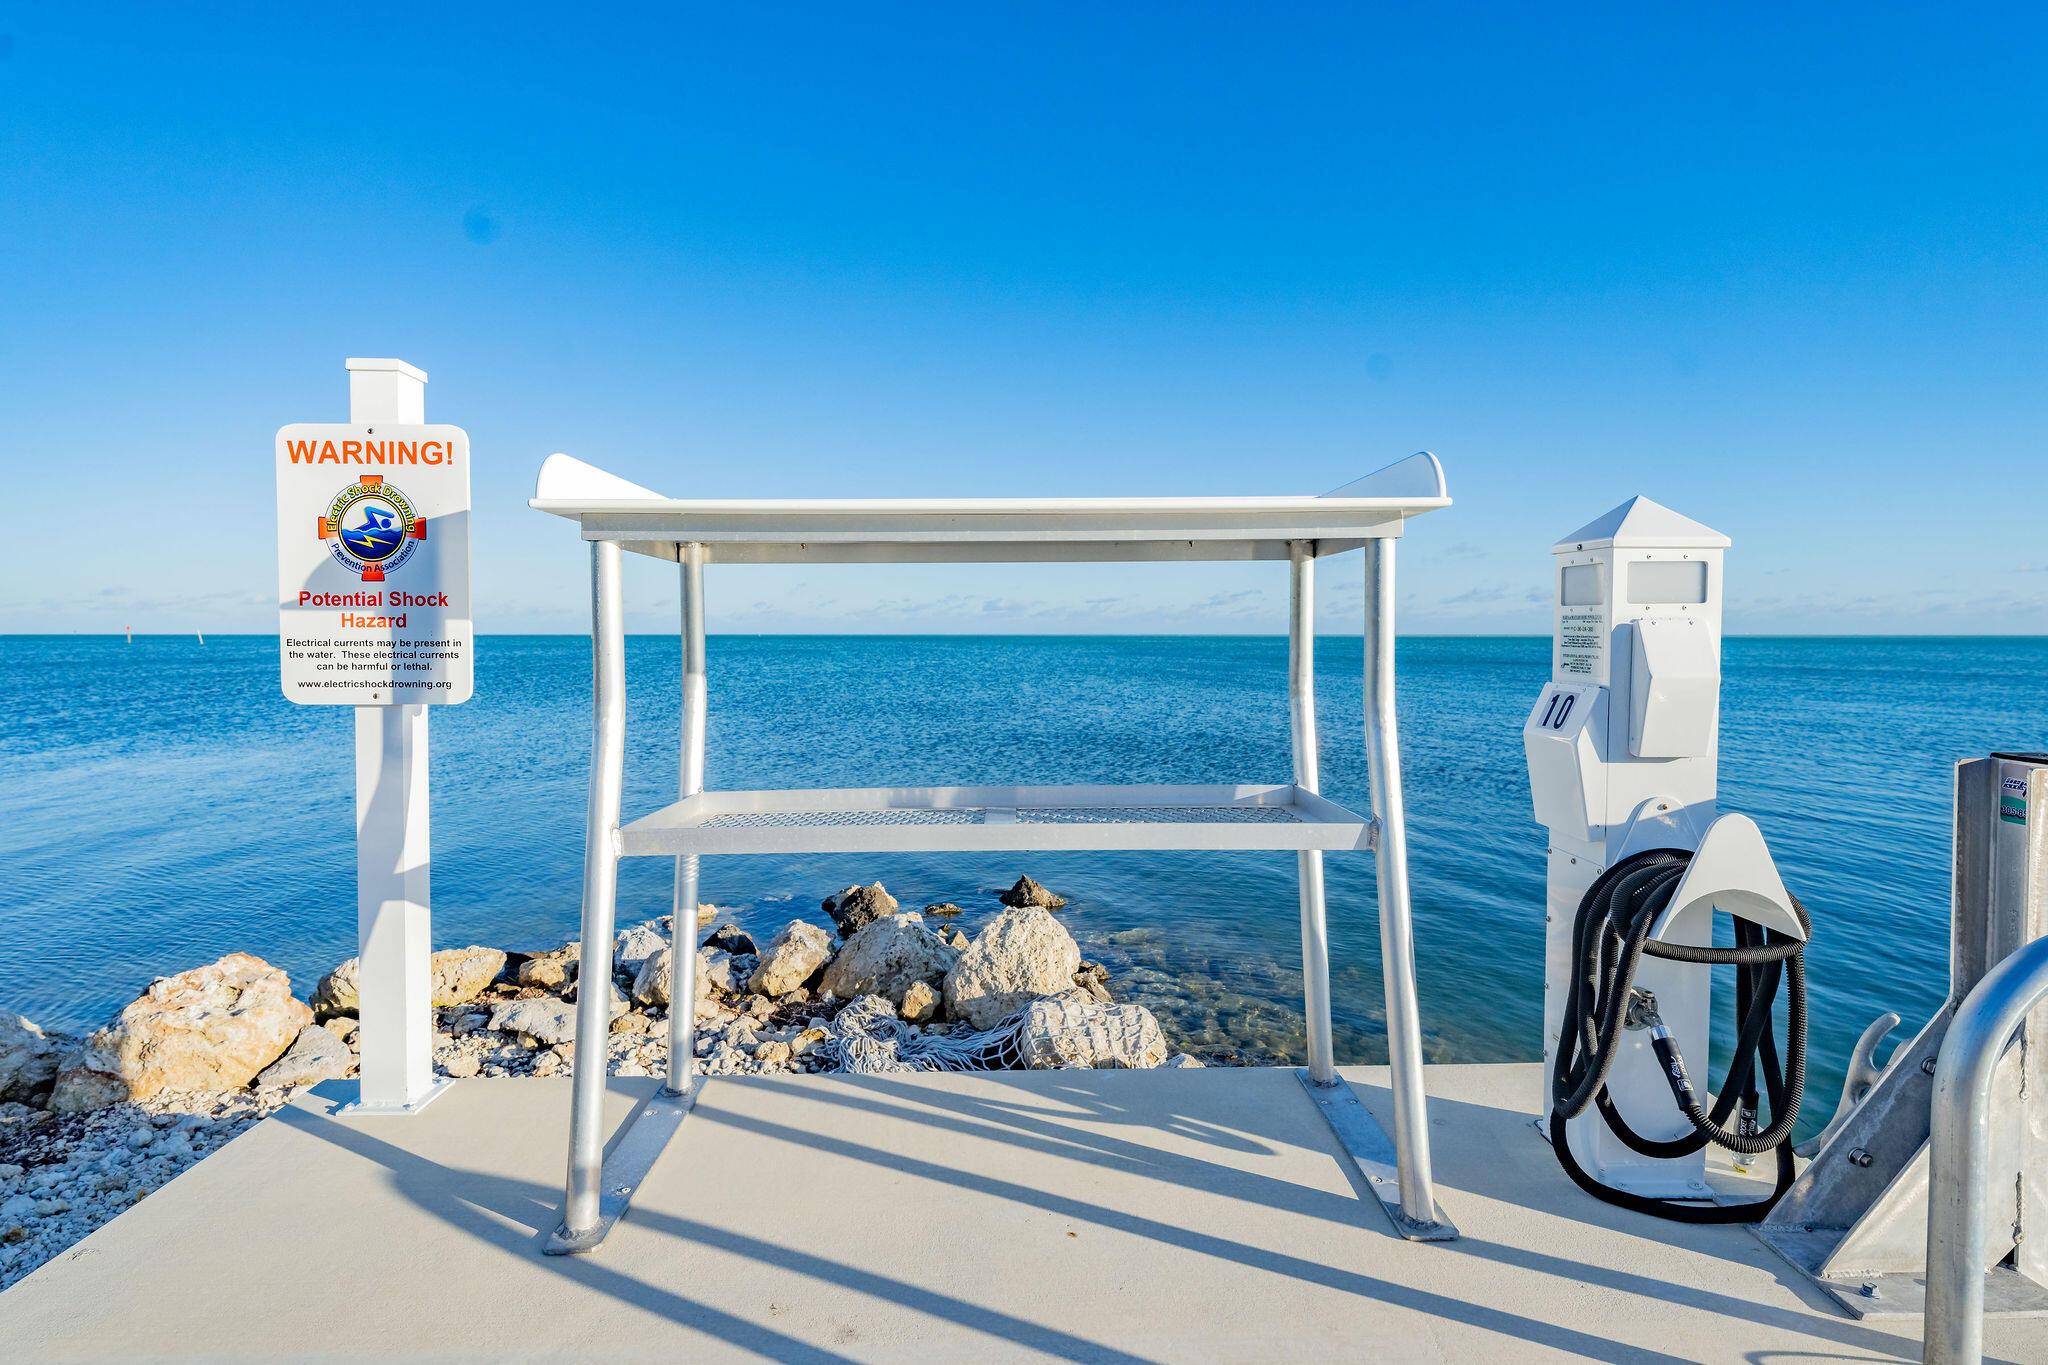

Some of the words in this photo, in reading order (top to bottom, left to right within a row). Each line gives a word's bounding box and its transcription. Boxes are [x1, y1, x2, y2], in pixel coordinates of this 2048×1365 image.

[287, 440, 453, 465] WARNING!
[327, 494, 350, 532] Electric
[347, 483, 382, 497] Shock
[382, 485, 416, 532] Drowning
[331, 543, 372, 573] Prevention
[374, 540, 415, 573] Association
[299, 591, 383, 607] Potential
[389, 591, 449, 607] Shock
[341, 613, 407, 628] Hazard
[286, 639, 331, 647] Electrical
[377, 641, 397, 649] may
[400, 639, 411, 647] be
[414, 640, 450, 649] present
[453, 639, 462, 647] in
[289, 651, 304, 659] the
[307, 651, 336, 659] water.
[342, 651, 370, 659] These
[373, 651, 417, 659] electrical
[419, 651, 459, 659] currents
[337, 662, 349, 671] be
[351, 662, 388, 671] harmful
[403, 662, 433, 671] lethal.
[298, 680, 452, 690] www.electricshockdrowning.org
[1542, 694, 1575, 729] 10
